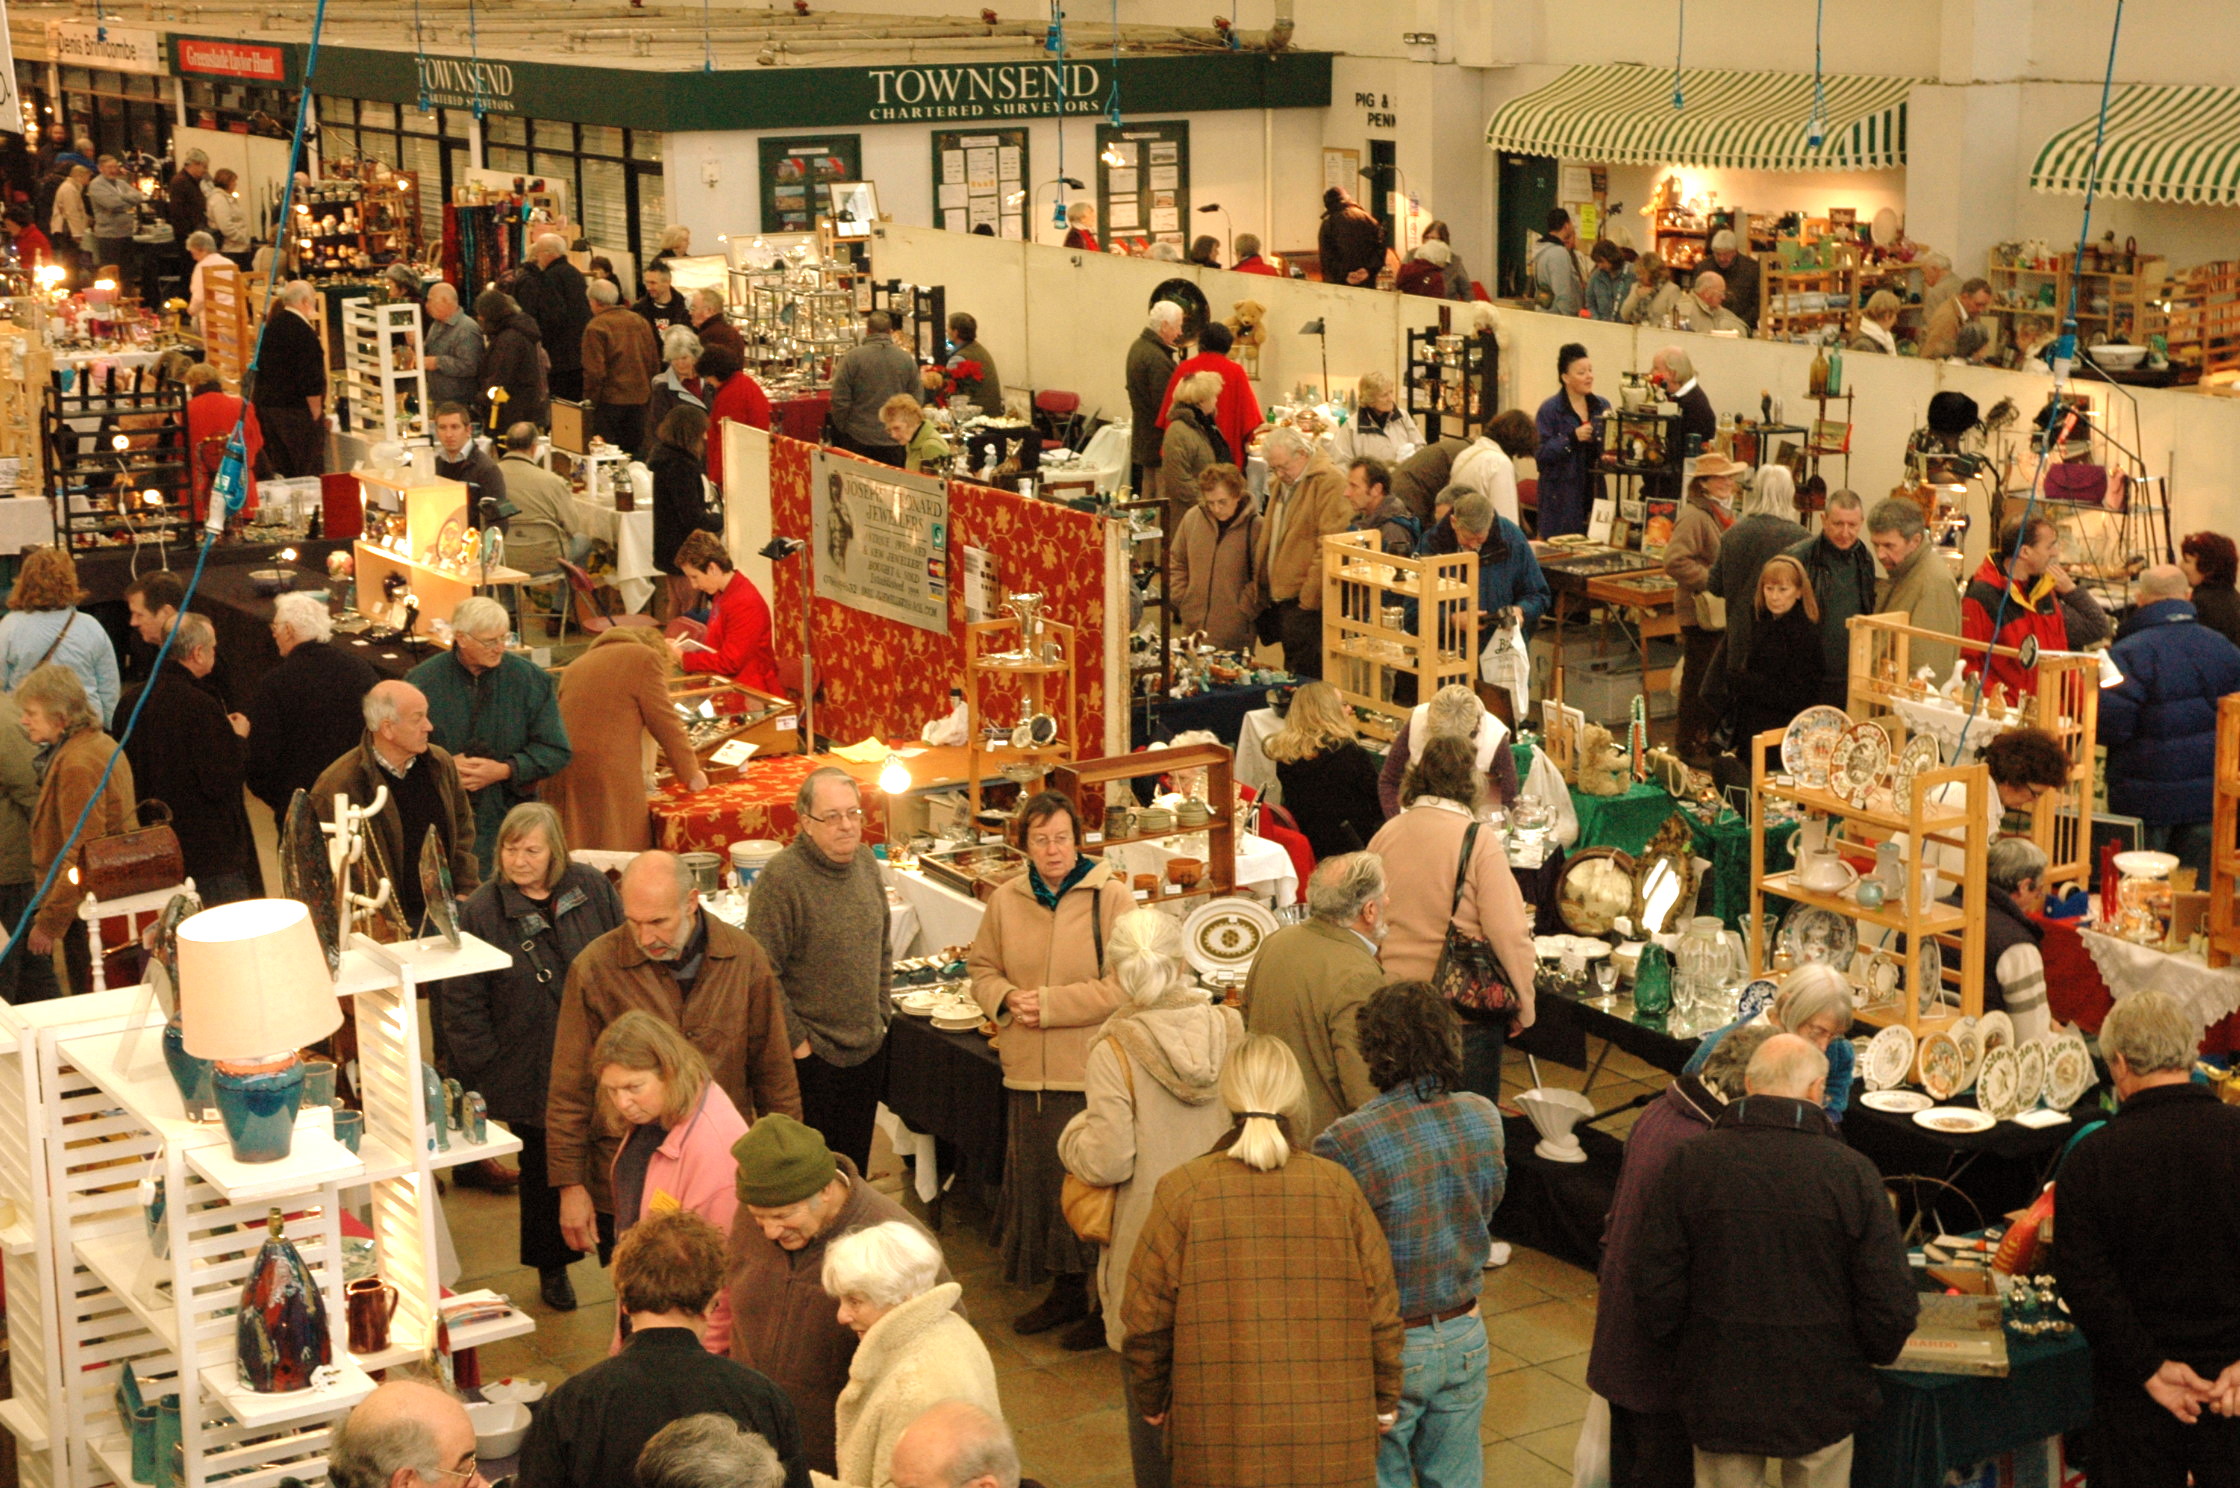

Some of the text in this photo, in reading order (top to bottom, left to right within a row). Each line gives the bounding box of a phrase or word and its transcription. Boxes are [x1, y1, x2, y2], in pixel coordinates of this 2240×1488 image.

[58, 31, 82, 56] Denis
[414, 57, 513, 96] TOWNSEND
[868, 65, 1100, 104] TOWNSEND
[869, 99, 1100, 120] CHARTERED SURVEYORS
[1355, 92, 1375, 108] PIG
[1381, 93, 1389, 109] &
[865, 504, 924, 532] JEWELLERS
[892, 490, 943, 518] EONARD
